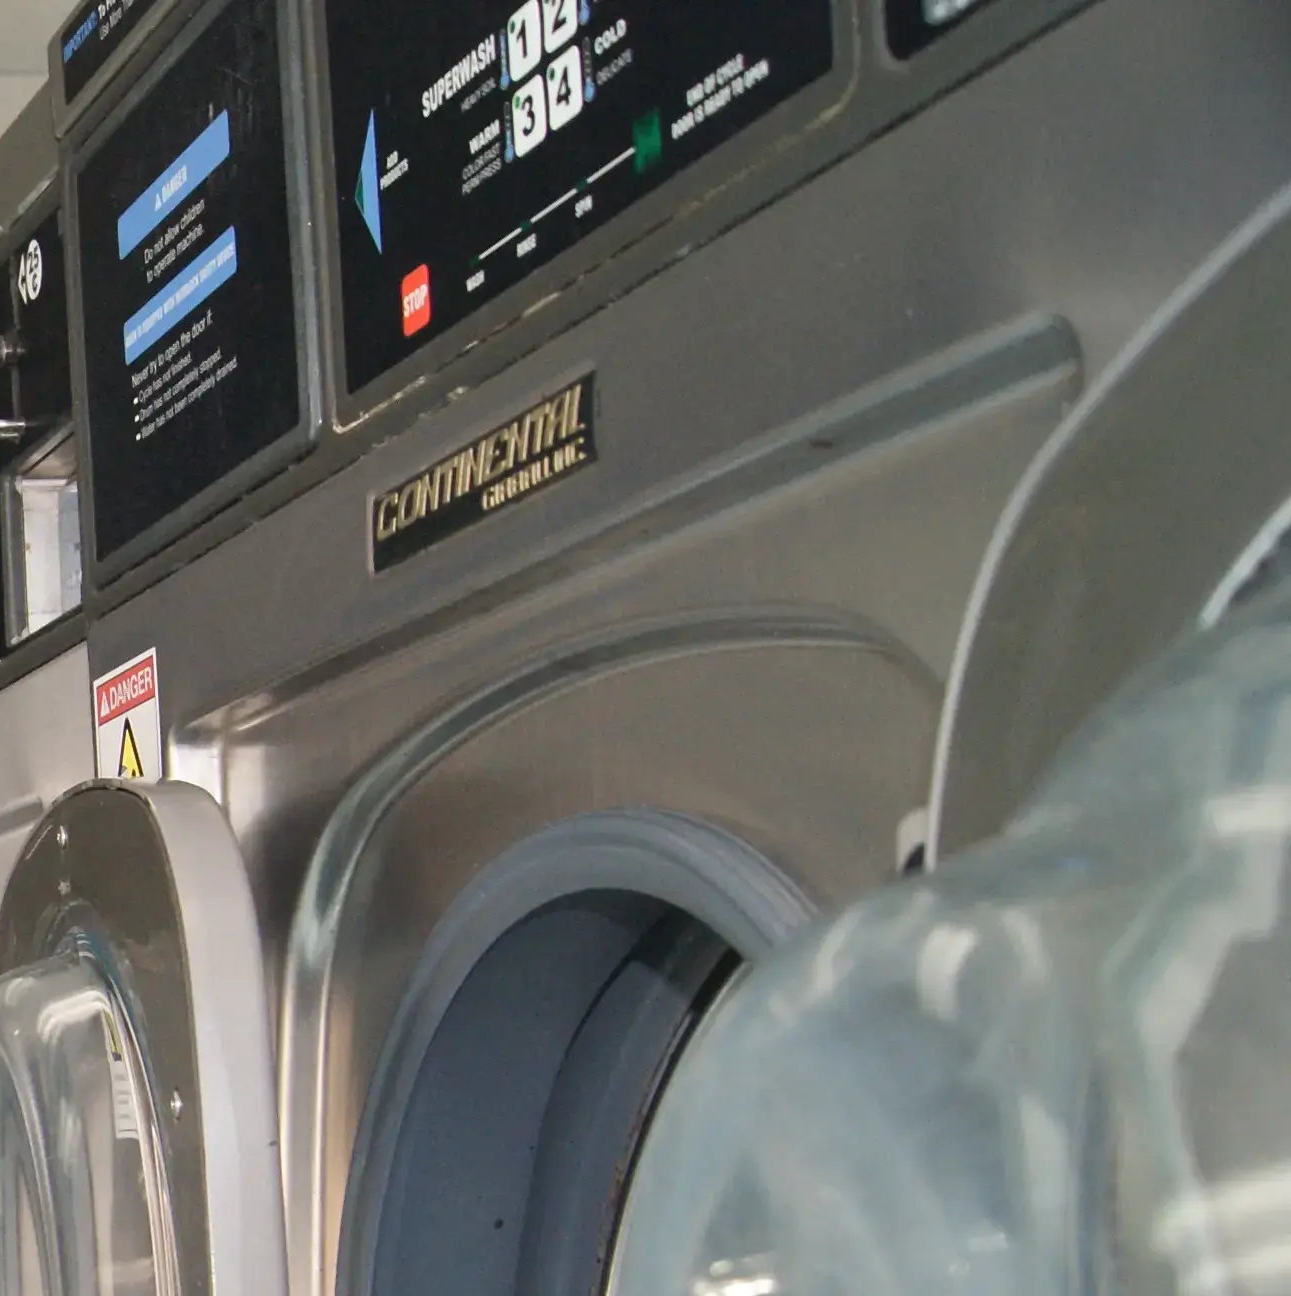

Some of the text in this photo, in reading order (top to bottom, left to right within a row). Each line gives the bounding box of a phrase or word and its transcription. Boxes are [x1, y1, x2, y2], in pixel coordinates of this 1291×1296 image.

[549, 0, 568, 35] 2
[593, 18, 627, 55] COLD
[516, 19, 528, 60] 1
[421, 33, 497, 118] SUPERWASH
[555, 66, 572, 107] 4
[521, 94, 536, 137] 3
[468, 118, 501, 156] WARM
[144, 199, 205, 264] Do not allow children
[27, 245, 39, 275] 25
[153, 248, 176, 279] operate
[402, 283, 428, 318] STOP
[132, 366, 149, 388] Never
[164, 340, 180, 361] open
[180, 331, 191, 348] the
[191, 317, 206, 339] door
[376, 383, 586, 541] CONTINENTAL
[109, 666, 153, 711] DANGER
